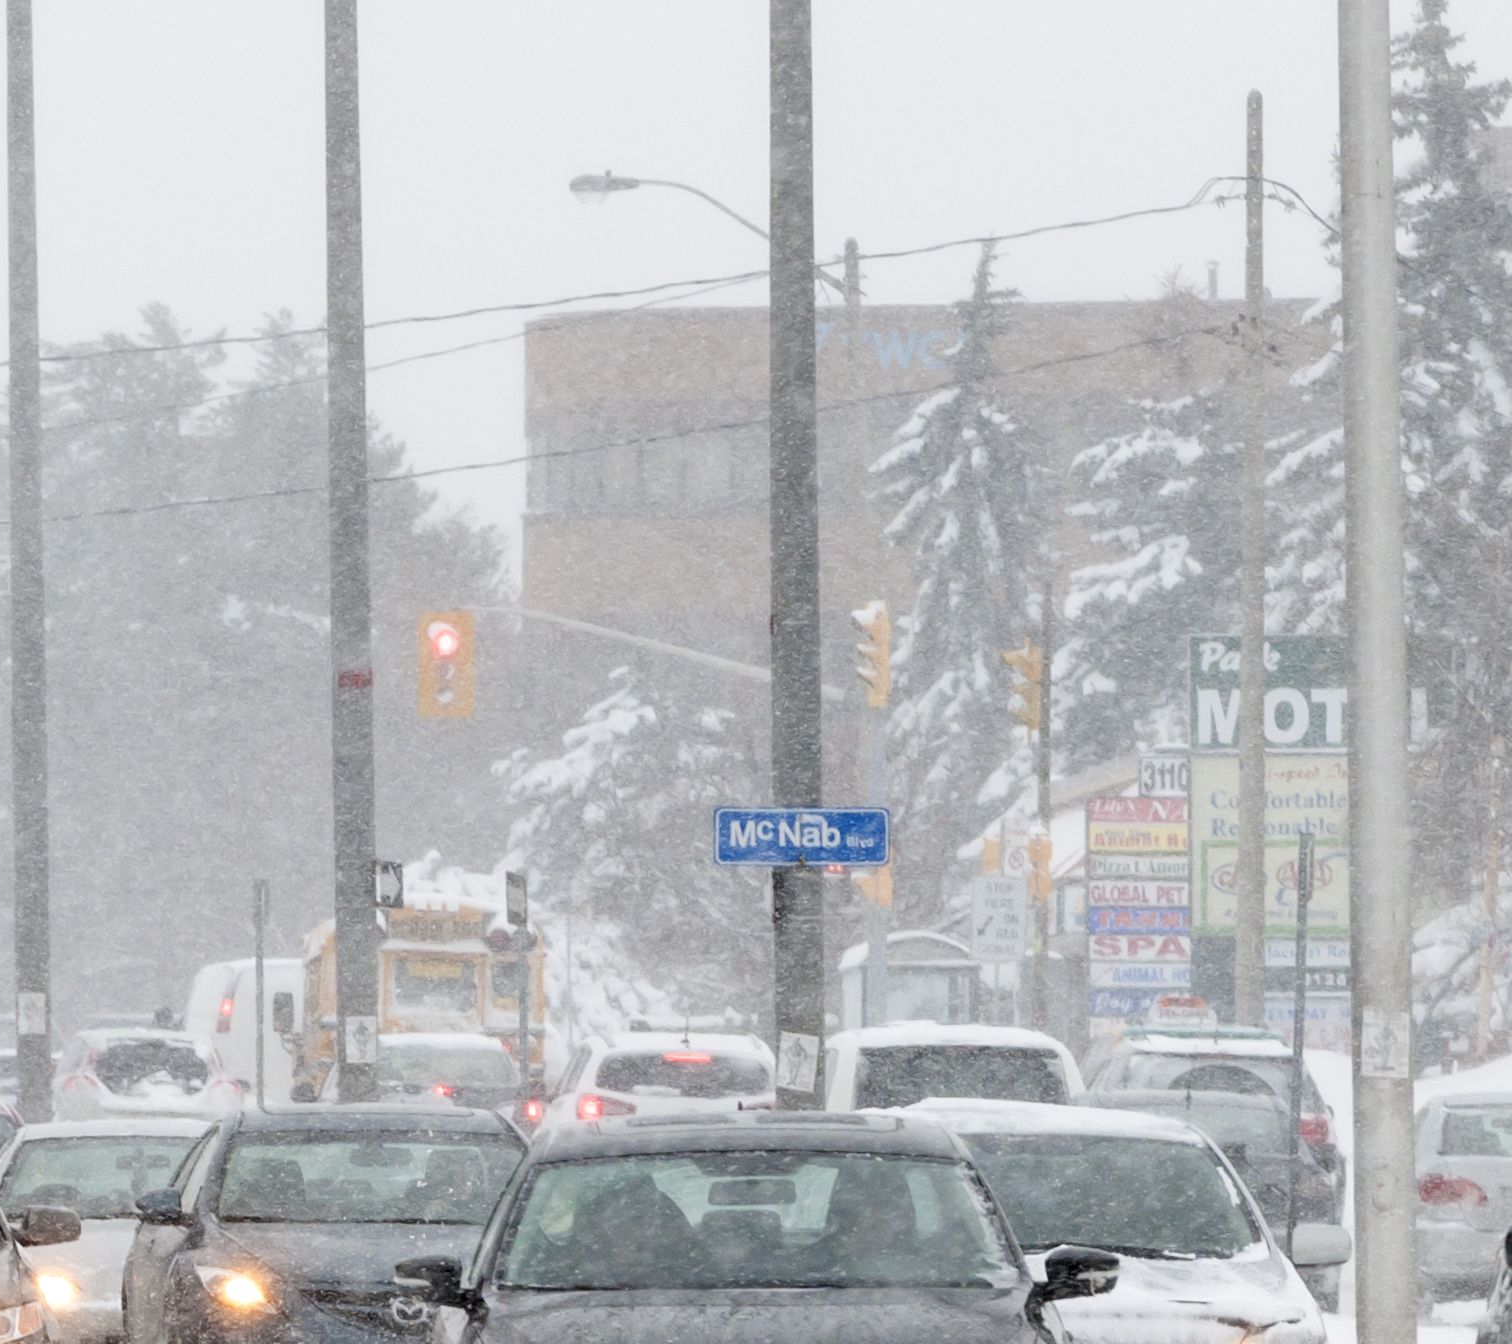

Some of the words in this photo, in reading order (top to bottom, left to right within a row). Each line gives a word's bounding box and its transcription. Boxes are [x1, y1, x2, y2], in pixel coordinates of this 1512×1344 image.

[1199, 640, 1282, 672] Pak
[1197, 687, 1442, 745] MOTL
[1091, 884, 1150, 904] GLOBAL
[1156, 885, 1185, 904] PET
[1093, 936, 1189, 959] SPA
